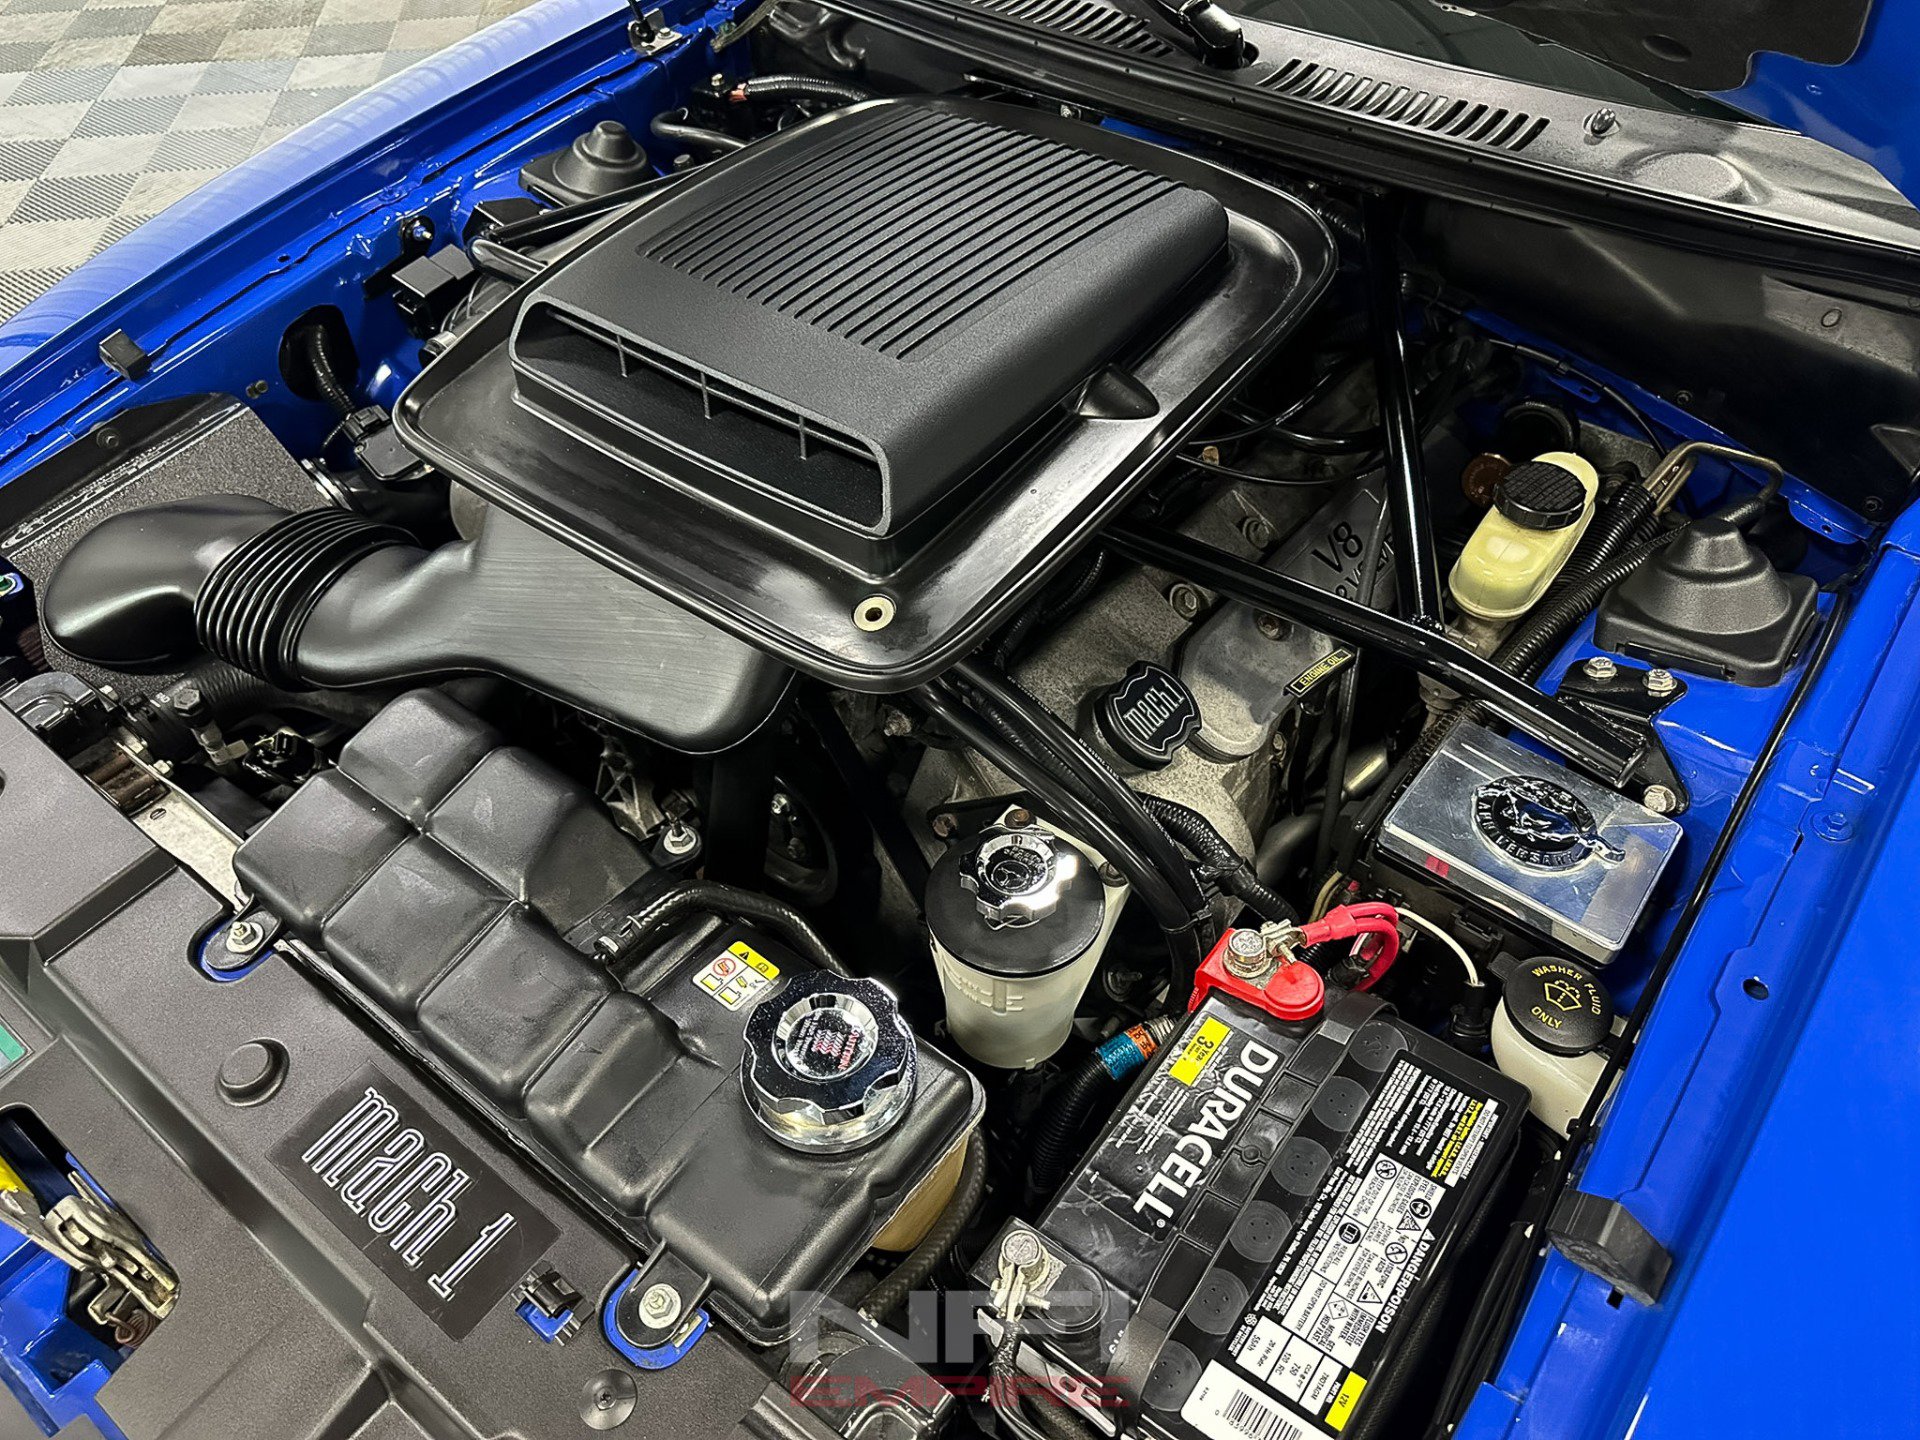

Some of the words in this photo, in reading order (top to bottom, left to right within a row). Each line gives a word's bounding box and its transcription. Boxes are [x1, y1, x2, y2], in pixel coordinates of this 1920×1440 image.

[1311, 521, 1363, 574] V8
[1299, 662, 1330, 687] ENGINE
[1327, 655, 1343, 666] OIL
[1531, 964, 1583, 981] WASHER
[1584, 982, 1602, 1016] FLUID
[1531, 1006, 1563, 1029] ONLY
[1196, 1035, 1215, 1050] 3
[1133, 1040, 1279, 1219] DURACELL
[1403, 1174, 1421, 1199] EXPLOSIVE
[1423, 1183, 1437, 1200] SHIELD
[1395, 1197, 1408, 1214] GASES
[1396, 1235, 1405, 1243] NO
[427, 1212, 515, 1298] 1
[1336, 1244, 1348, 1257] READ
[1331, 1255, 1341, 1266] ALL
[1374, 1260, 1385, 1273] ACID
[1318, 1278, 1328, 1288] DO
[1376, 1264, 1393, 1288] SULFURIC
[1312, 1286, 1323, 1299] NOT
[1374, 1240, 1430, 1334] DANGER/POISON
[1305, 1296, 1317, 1311] OPEN
[1318, 1314, 1330, 1329] HELP
[1347, 1307, 1360, 1322] WITH
[1337, 1320, 1353, 1341] WATER.
[1344, 1311, 1367, 1346] IMMEDIATELY
[1360, 1315, 1374, 1333] FLUSH
[1310, 1326, 1323, 1343] FAST.
[1317, 1323, 1334, 1347] MEDICAL
[1353, 1331, 1365, 1347] EYES
[1246, 1333, 1261, 1353] 55Ah
[1263, 1346, 1272, 1355] Hr
[1267, 1338, 1276, 1348] 20
[1324, 1339, 1335, 1352] GET
[1255, 1353, 1268, 1368] Rate
[1280, 1351, 1292, 1364] 120
[1274, 1363, 1285, 1376] RC
[1288, 1362, 1301, 1376] 750
[1302, 1363, 1312, 1375] CCA
[1336, 1392, 1350, 1408] 12V
